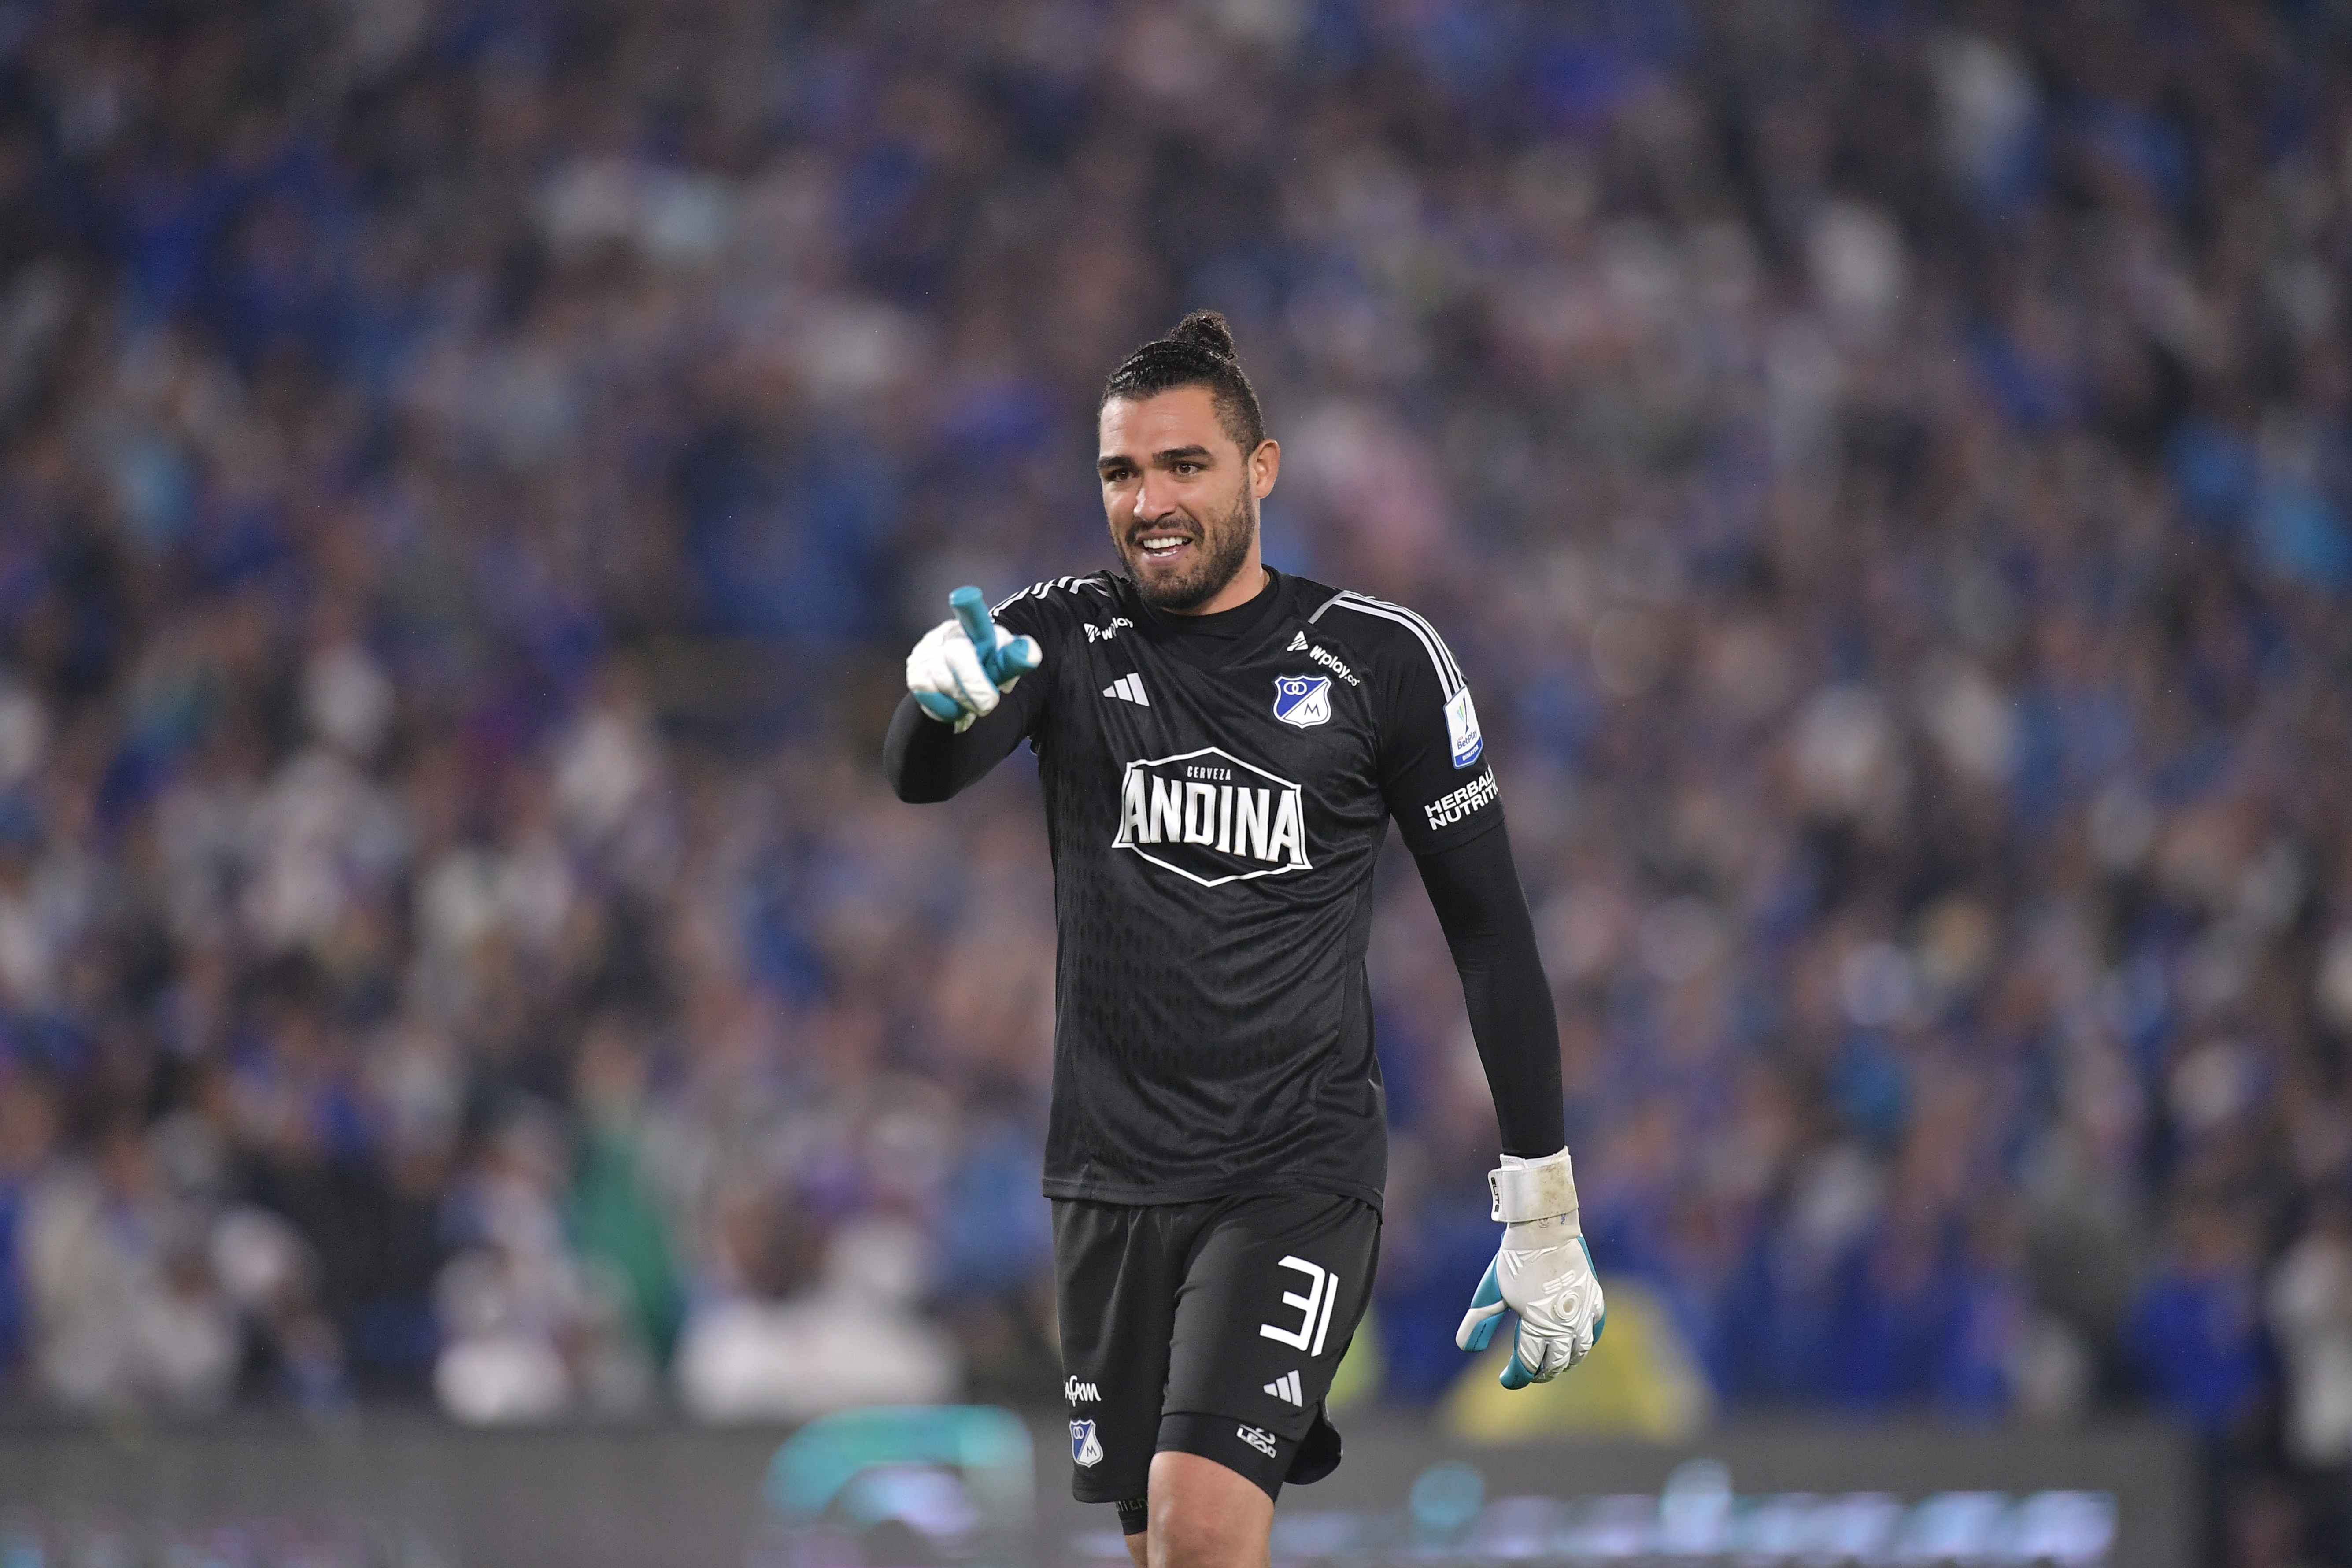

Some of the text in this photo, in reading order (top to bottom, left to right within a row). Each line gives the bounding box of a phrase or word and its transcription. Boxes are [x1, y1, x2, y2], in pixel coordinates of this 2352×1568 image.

[1304, 703, 1320, 717] M
[1457, 729, 1477, 750] BetPlay
[1462, 744, 1479, 761] DIMAYOR
[1187, 766, 1231, 781] CERVEZA
[1121, 769, 1303, 864] ANDINA
[1491, 1177, 1500, 1212] ELITE
[1259, 1255, 1339, 1357] 31
[1086, 1445, 1097, 1457] M
